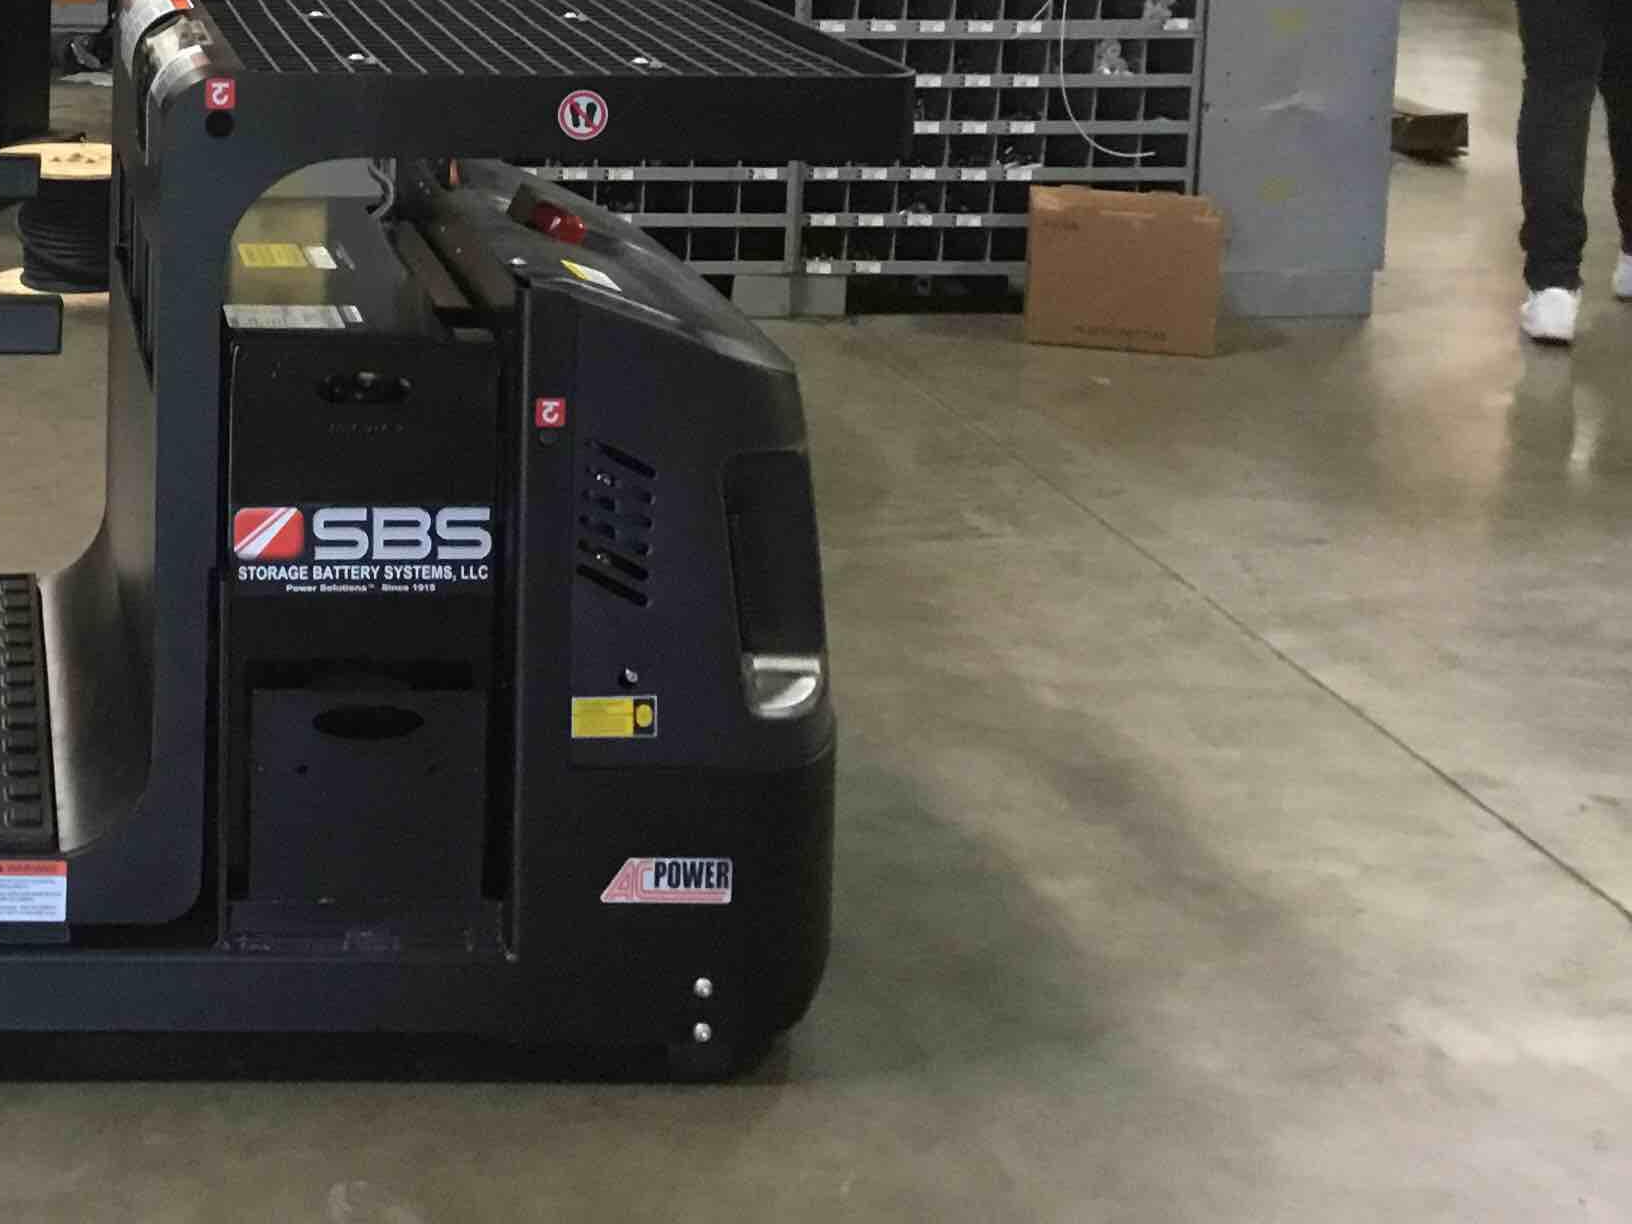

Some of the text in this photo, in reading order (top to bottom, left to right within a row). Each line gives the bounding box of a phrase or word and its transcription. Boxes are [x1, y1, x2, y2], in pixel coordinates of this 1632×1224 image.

[312, 506, 493, 561] SBS
[237, 564, 489, 582] STORAGE BATTERY SYSTEMS, LLC
[286, 584, 317, 592] Power
[381, 584, 410, 592] Since
[653, 860, 730, 890] POWER
